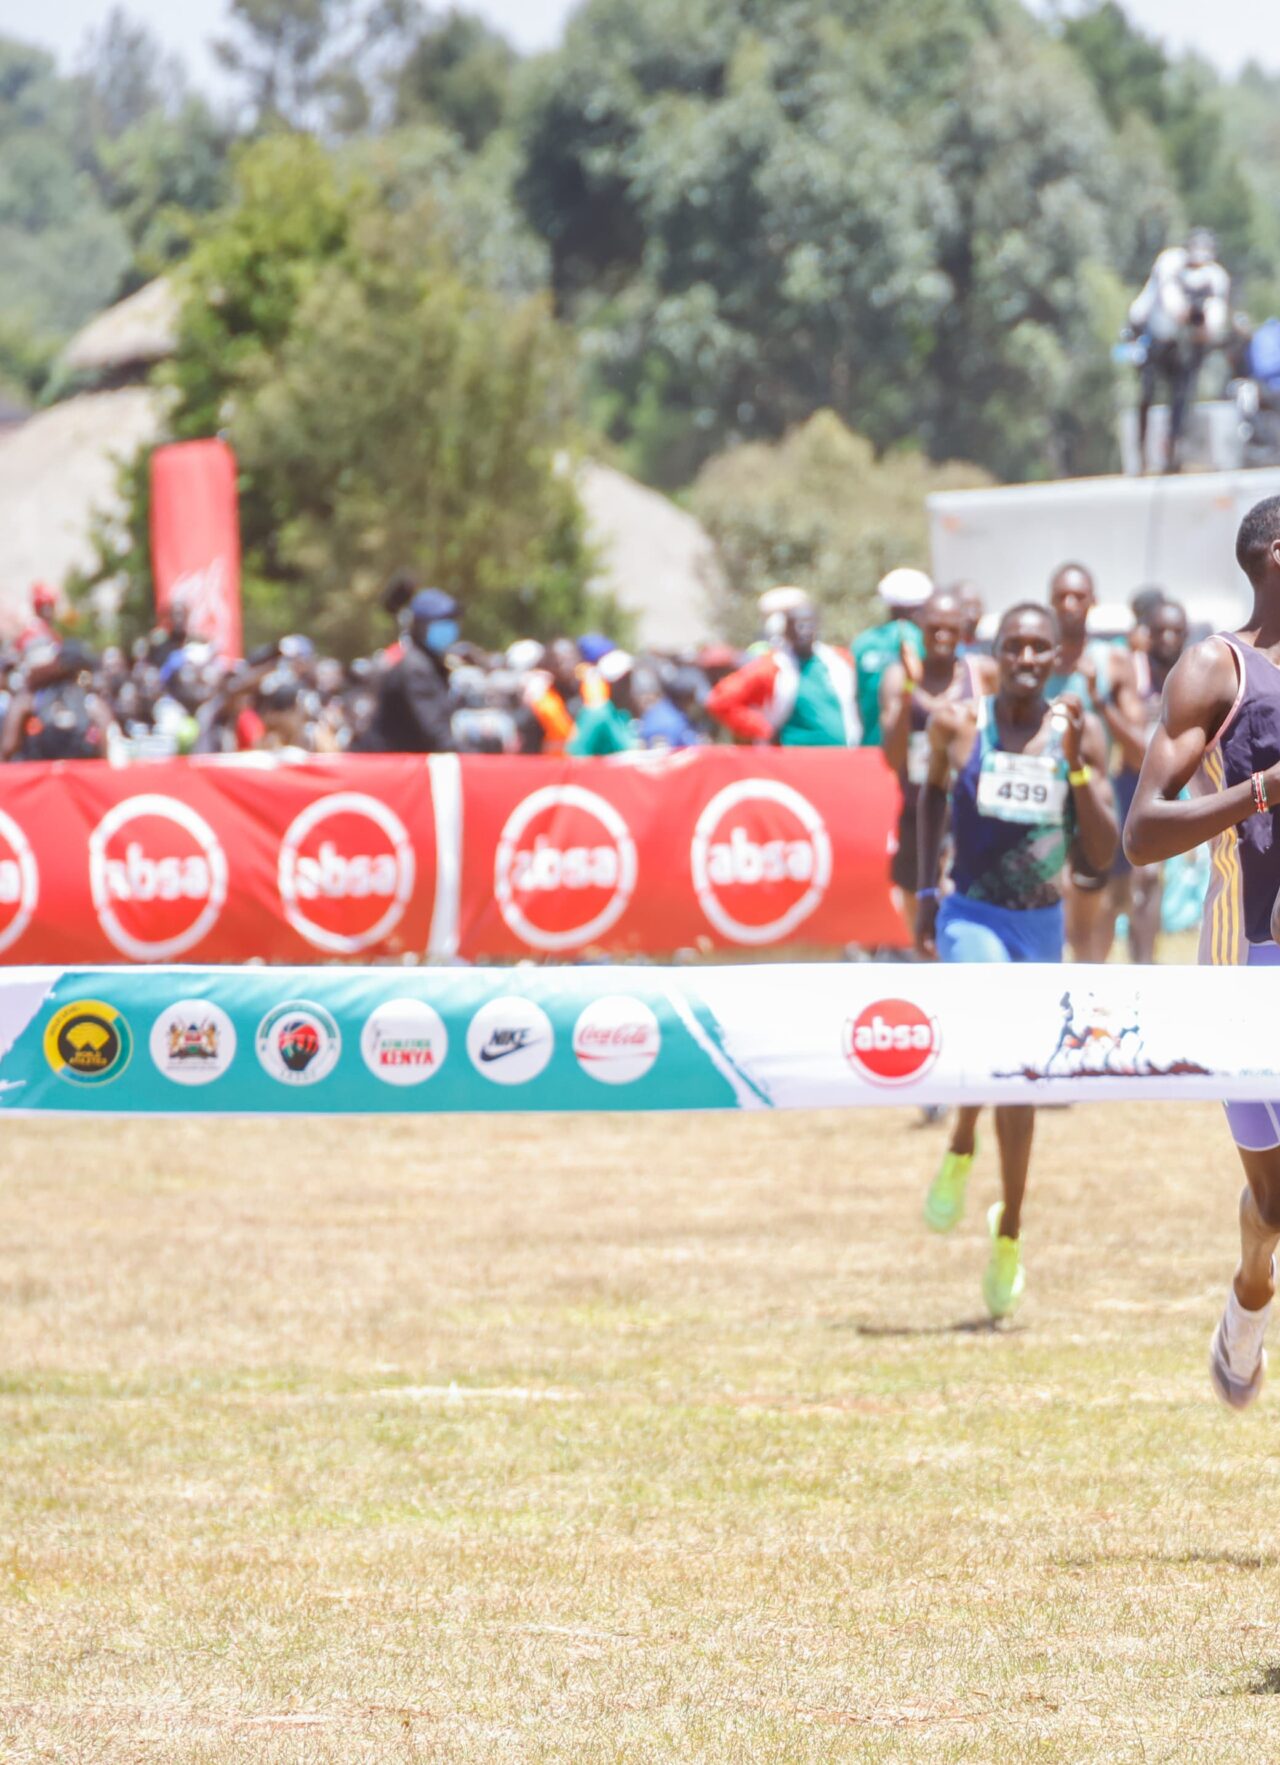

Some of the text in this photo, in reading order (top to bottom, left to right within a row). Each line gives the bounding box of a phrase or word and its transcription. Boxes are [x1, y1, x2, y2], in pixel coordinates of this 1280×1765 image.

[997, 782, 1047, 803] 439
[296, 841, 397, 899] absa
[511, 834, 618, 891] absa
[707, 826, 814, 884] absa
[489, 1027, 530, 1047] NIKE
[855, 1015, 931, 1051] absa
[380, 1049, 434, 1065] KENYA
